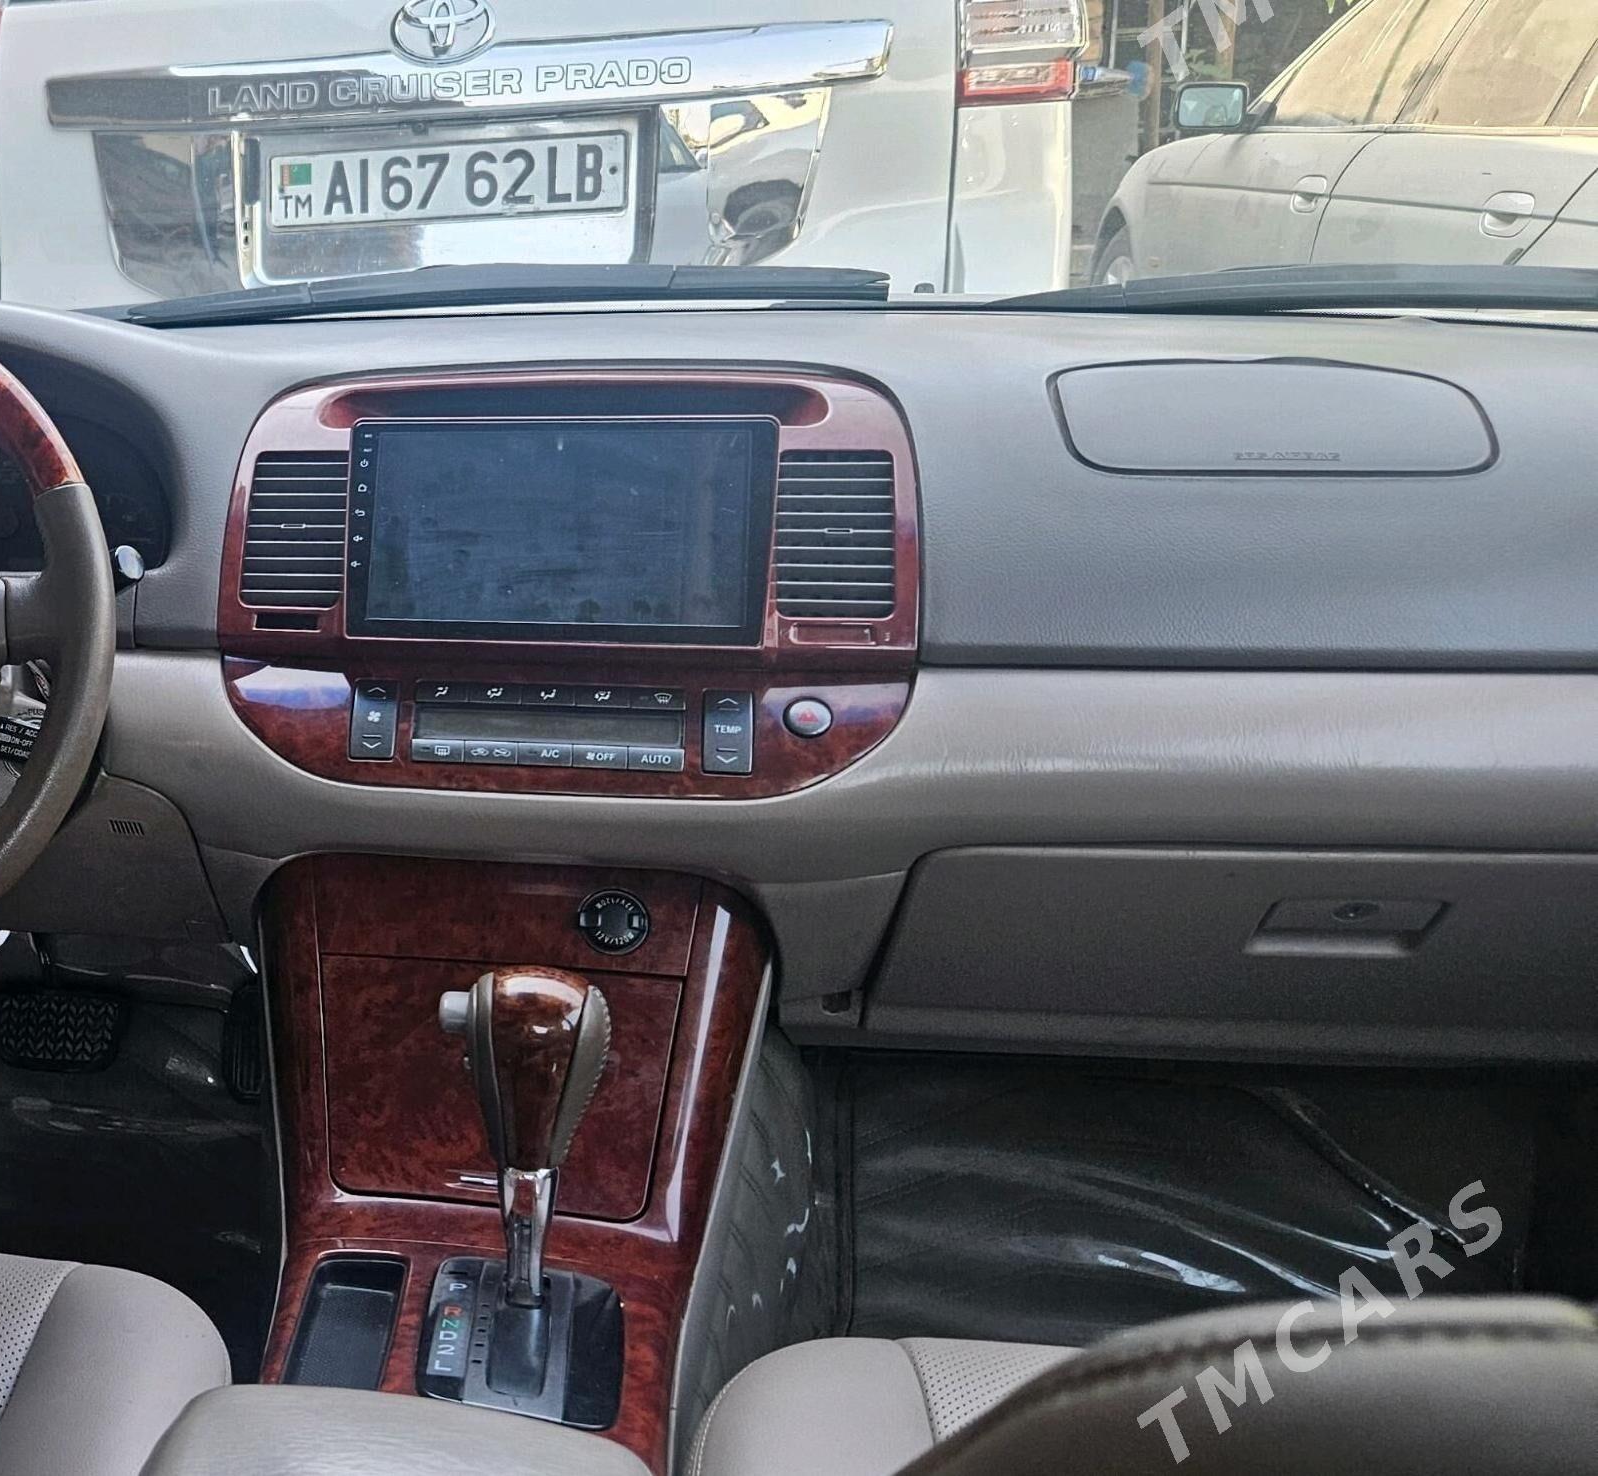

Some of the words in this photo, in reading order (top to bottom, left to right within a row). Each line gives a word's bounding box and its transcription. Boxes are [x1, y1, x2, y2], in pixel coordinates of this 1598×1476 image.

[208, 81, 320, 115] LAND
[328, 68, 522, 107] CRUISER
[536, 56, 691, 92] PRADO
[279, 194, 312, 219] TM
[714, 724, 742, 734] TEMP
[540, 749, 560, 759] A/C
[596, 752, 615, 762] OFF
[641, 754, 671, 765] AUTO
[449, 1283, 468, 1292] P
[439, 1331, 457, 1341] D
[434, 1360, 452, 1372] L
